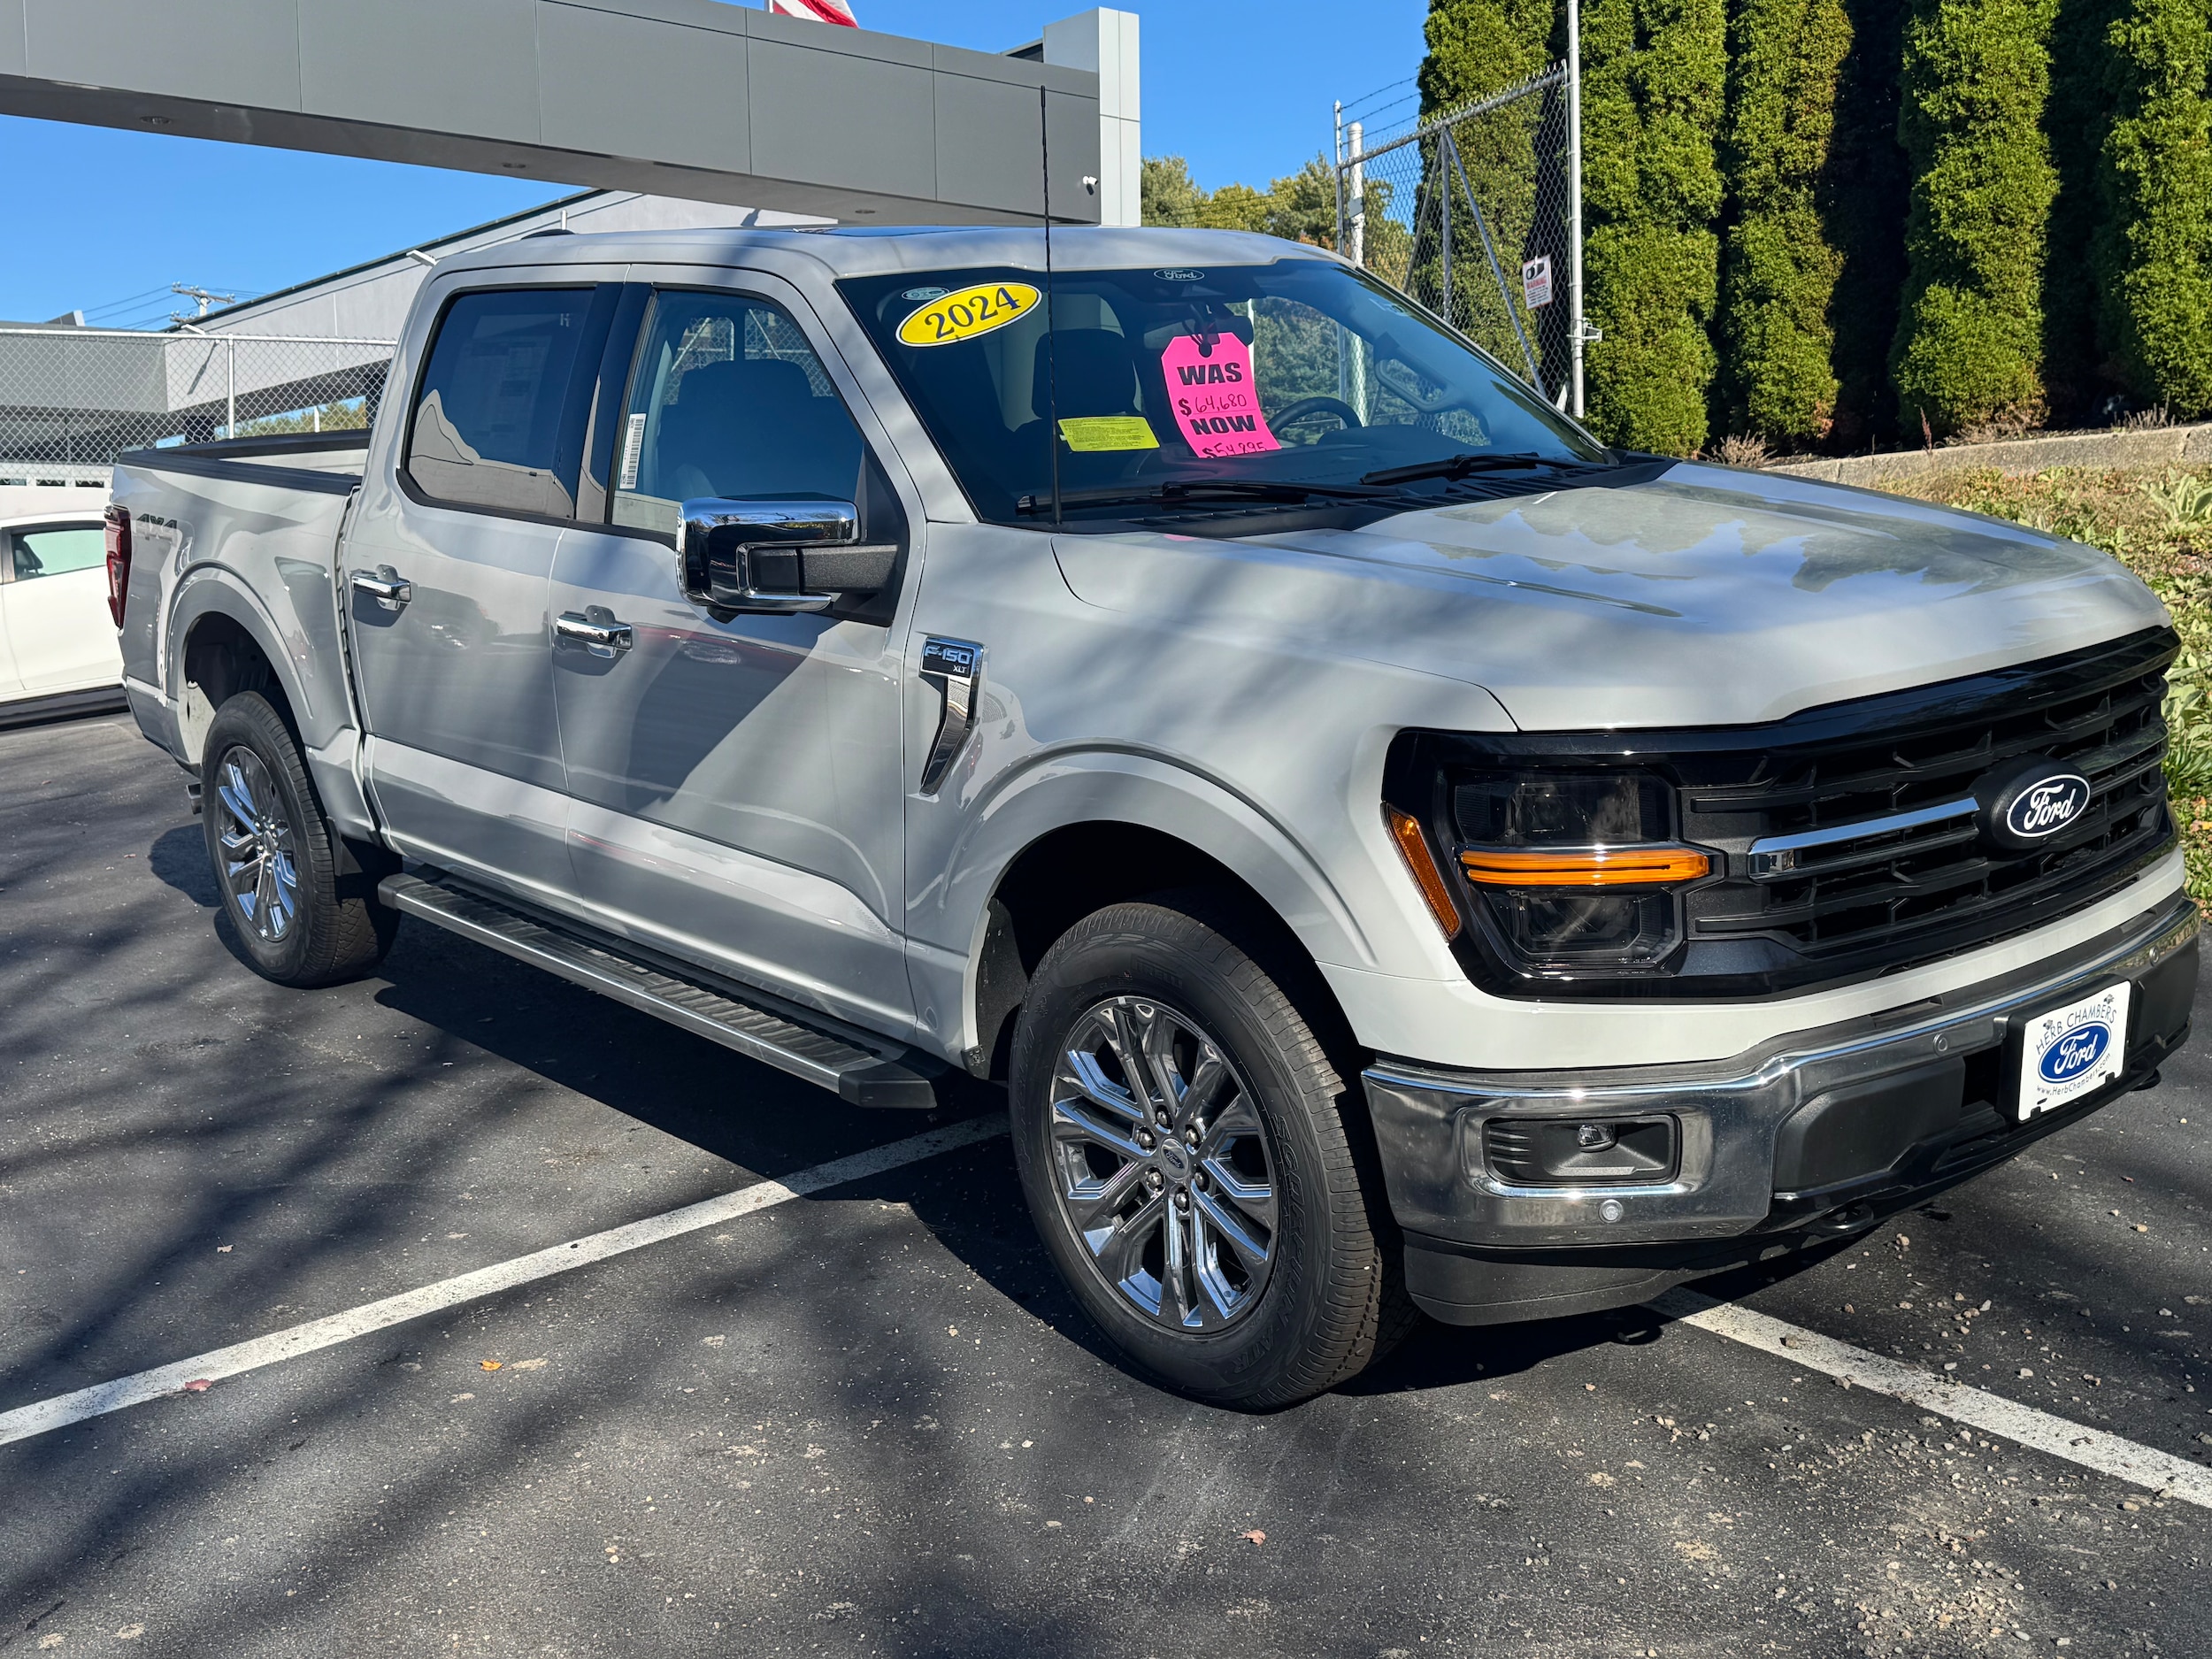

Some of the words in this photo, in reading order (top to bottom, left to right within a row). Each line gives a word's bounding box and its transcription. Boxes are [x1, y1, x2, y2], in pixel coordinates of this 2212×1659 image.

[1164, 270, 1197, 280] Ford
[925, 287, 1021, 340] 2024
[1177, 362, 1242, 386] WAS
[1189, 414, 1257, 435] NOW
[924, 646, 973, 664] F-150
[953, 664, 968, 673] XLT
[2024, 783, 2077, 830] Ford
[2036, 1020, 2063, 1056] HERB
[2066, 1003, 2117, 1028] CHAMBERS
[2054, 1031, 2099, 1075] Ford
[2036, 1052, 2112, 1096] www.HerbChambers.com
